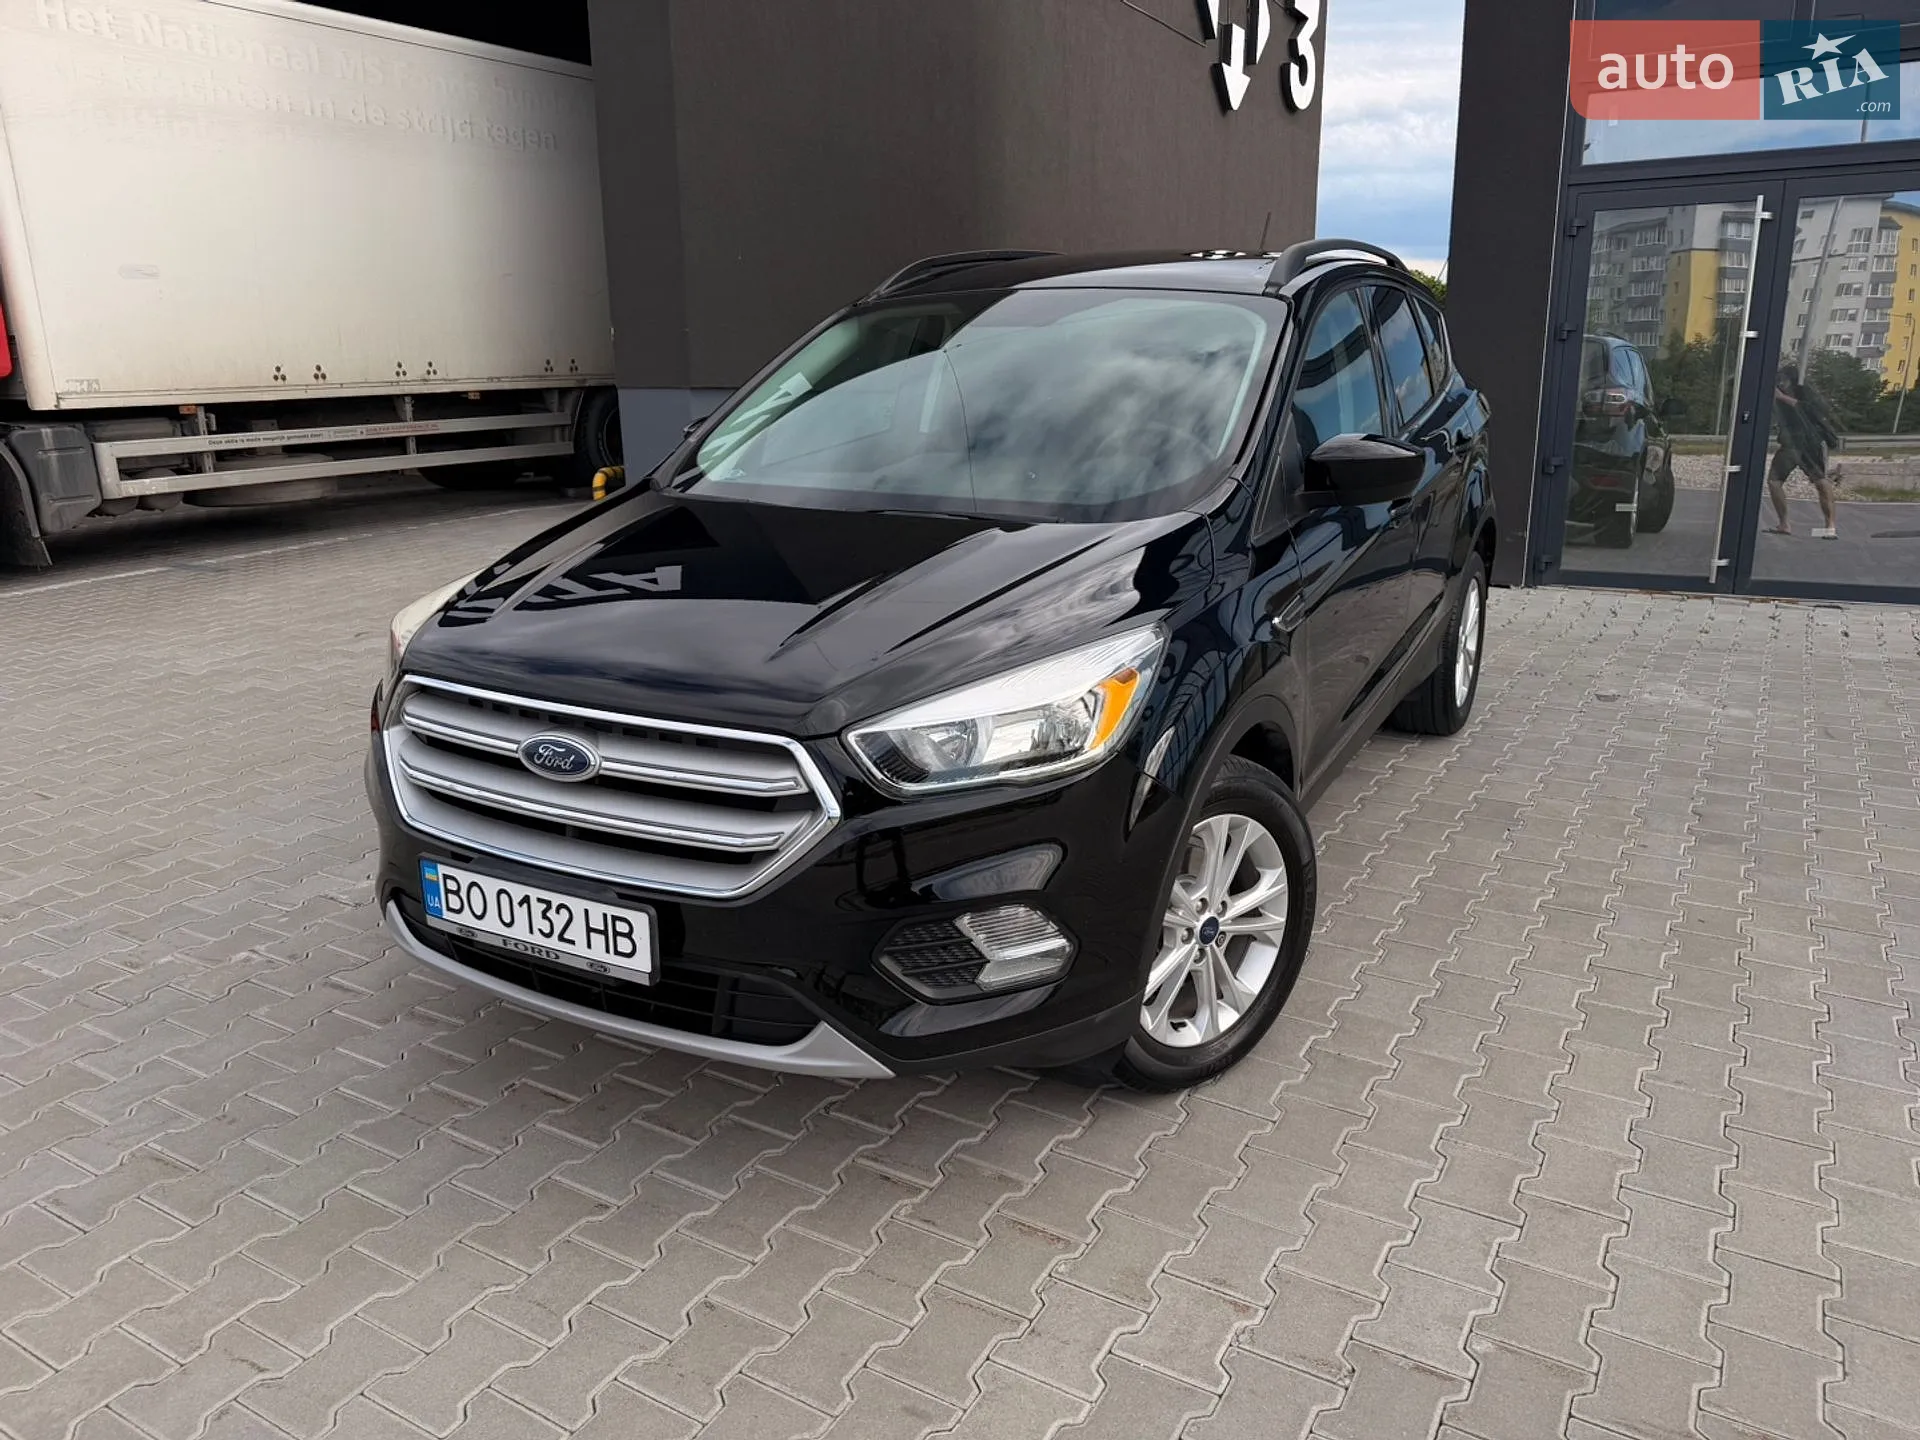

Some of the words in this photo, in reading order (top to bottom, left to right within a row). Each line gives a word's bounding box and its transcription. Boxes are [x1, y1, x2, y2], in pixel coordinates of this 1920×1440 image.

[130, 10, 319, 73] Nationaal
[350, 92, 388, 126] de
[398, 103, 475, 143] strijd
[484, 114, 558, 152] tegen
[533, 743, 576, 770] Ford
[426, 894, 442, 909] UA
[442, 873, 488, 921] BO
[495, 888, 577, 946] 0132
[583, 907, 638, 959] HB
[501, 937, 561, 961] FORD
